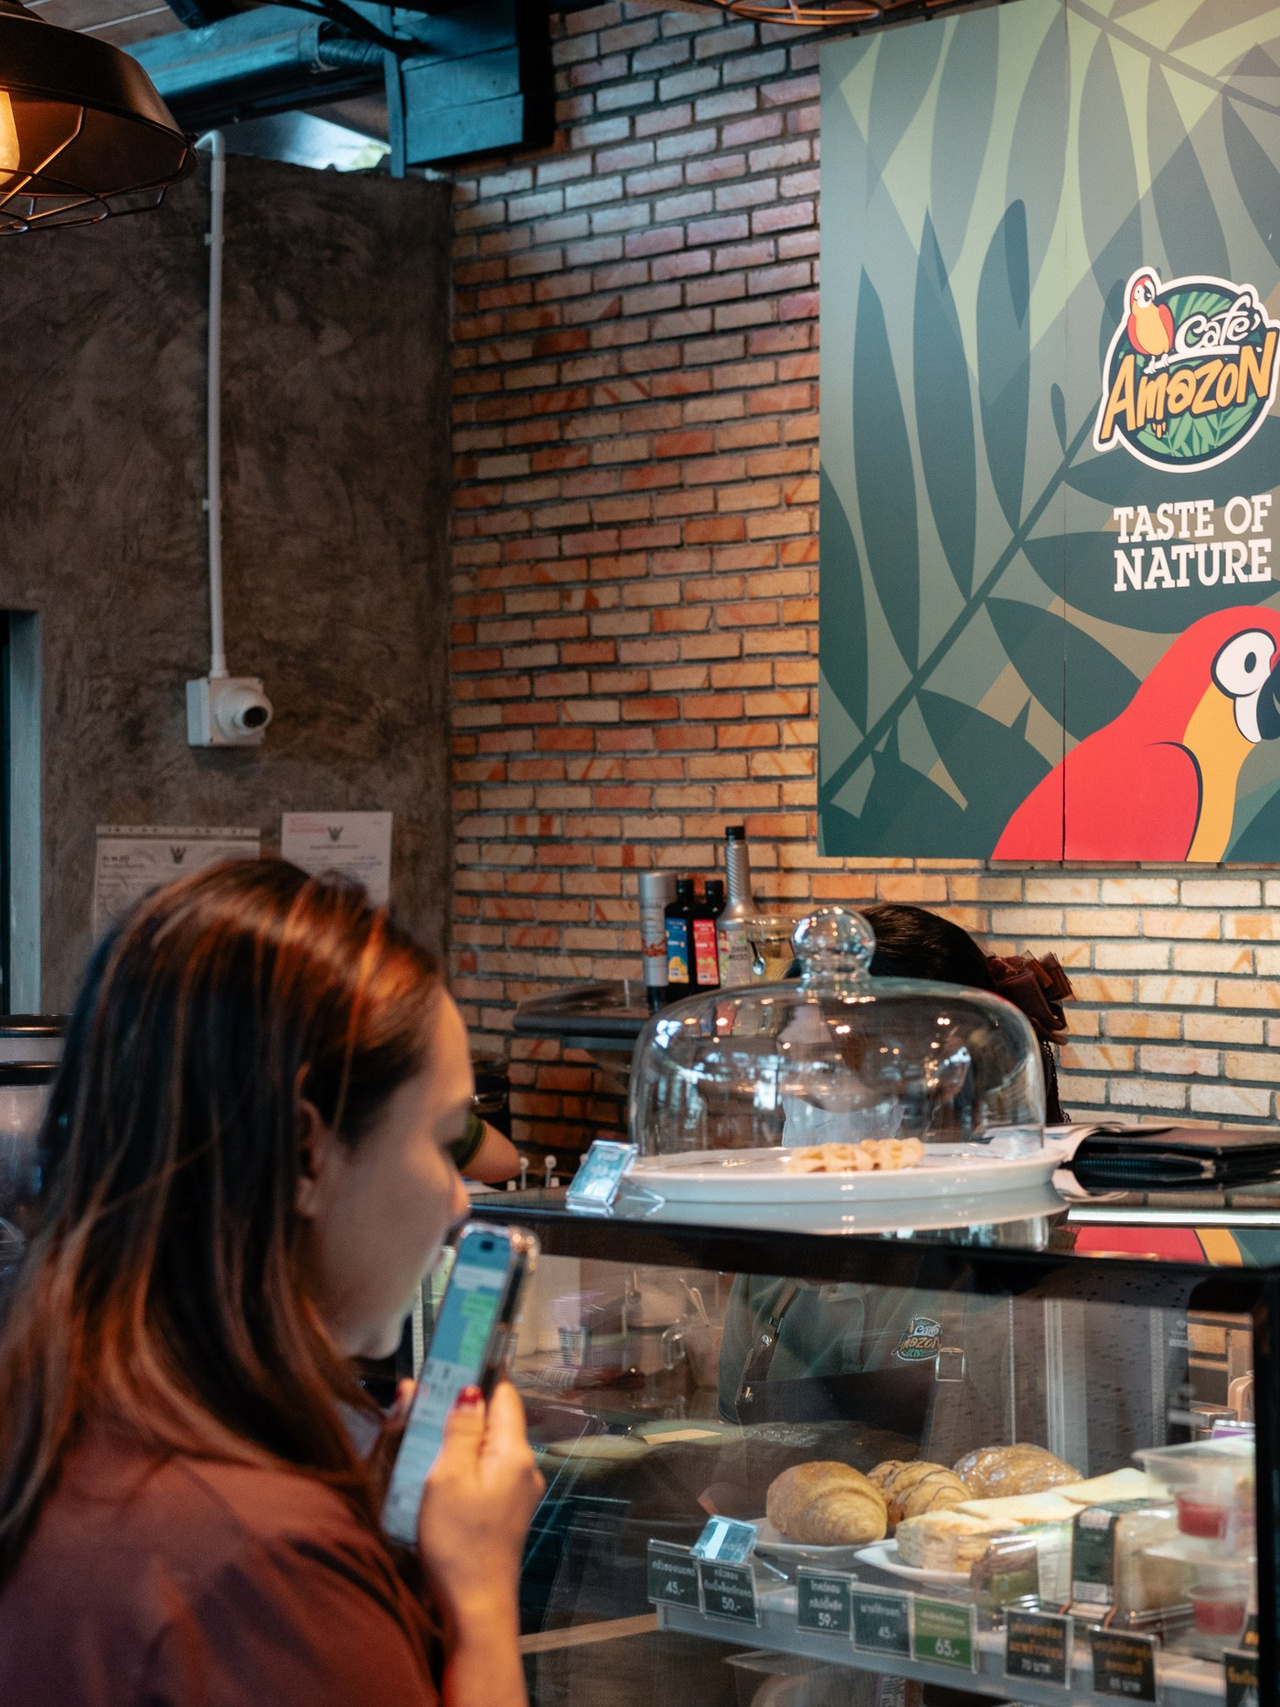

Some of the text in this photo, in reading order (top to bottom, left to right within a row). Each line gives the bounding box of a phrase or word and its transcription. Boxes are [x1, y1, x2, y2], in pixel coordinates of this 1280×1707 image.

[1113, 494, 1272, 543] TASTE OF
[1114, 538, 1271, 591] NATURE
